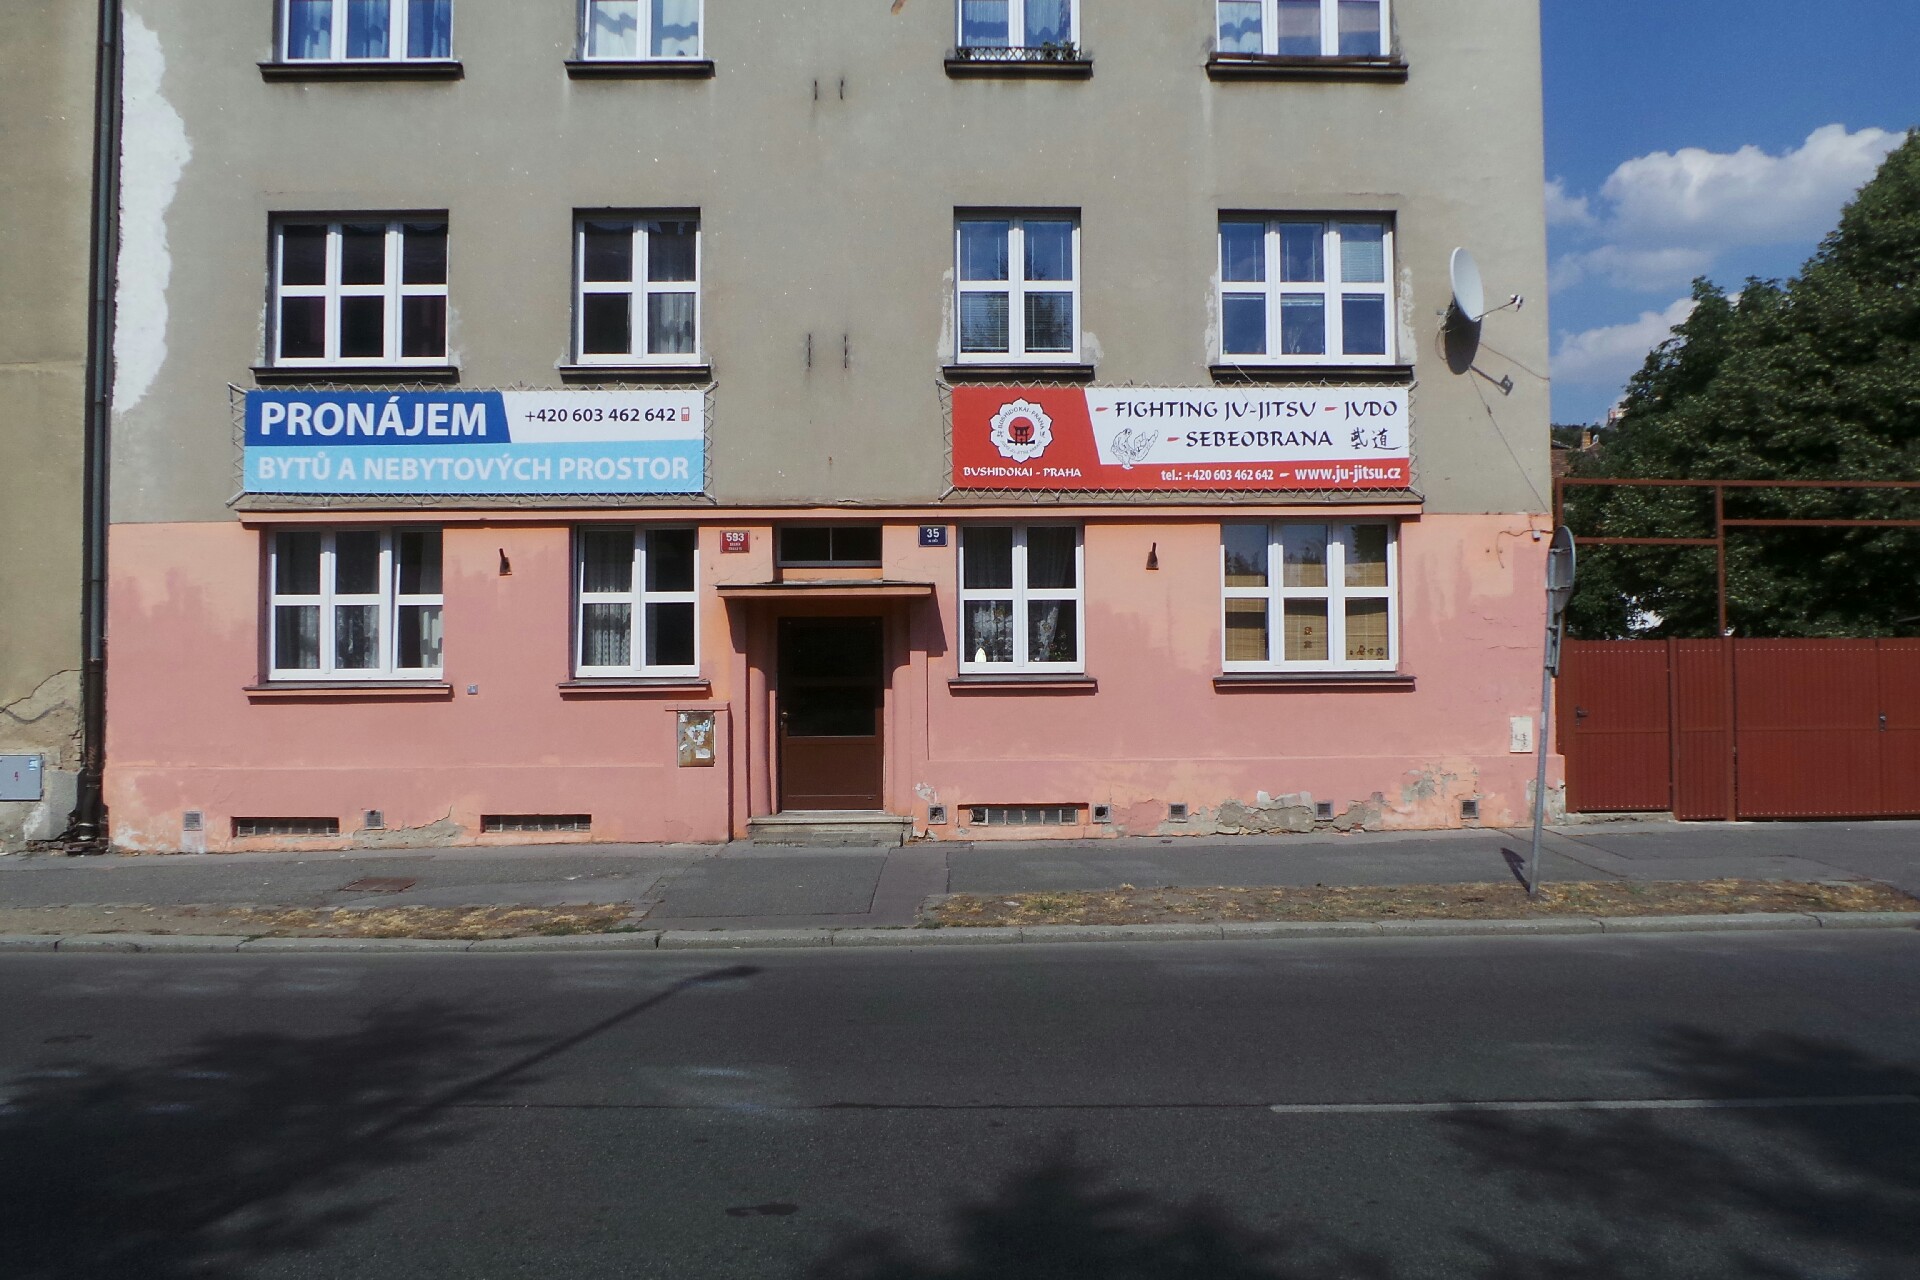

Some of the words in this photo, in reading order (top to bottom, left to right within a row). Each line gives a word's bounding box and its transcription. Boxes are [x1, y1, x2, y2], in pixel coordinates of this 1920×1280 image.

[261, 396, 487, 437] PRONÁJEM
[524, 408, 568, 422] +420
[572, 408, 604, 422] 603
[608, 408, 640, 422] 462
[644, 408, 676, 422] 642
[1115, 401, 1218, 418] FIGHTING
[1224, 401, 1317, 421] JU-JITSU
[1344, 400, 1398, 420] JUDO
[1186, 430, 1334, 448] SEBEOBRANA
[258, 451, 331, 480] BYTŮ
[337, 458, 357, 480] A
[363, 452, 551, 480] NEBYTOVÝCH
[559, 456, 689, 480] PROSTOR
[962, 466, 1033, 477] BUSHIDOKAI
[1042, 467, 1082, 477] PRAHA
[1160, 469, 1183, 481] tel.:
[1183, 469, 1212, 481] +420
[1213, 469, 1233, 481] 603
[1234, 469, 1254, 481] 462
[1254, 469, 1274, 480] 642
[1294, 464, 1401, 484] www.ju-jitsu.cz
[726, 532, 745, 542] 593
[926, 528, 940, 538] 35
